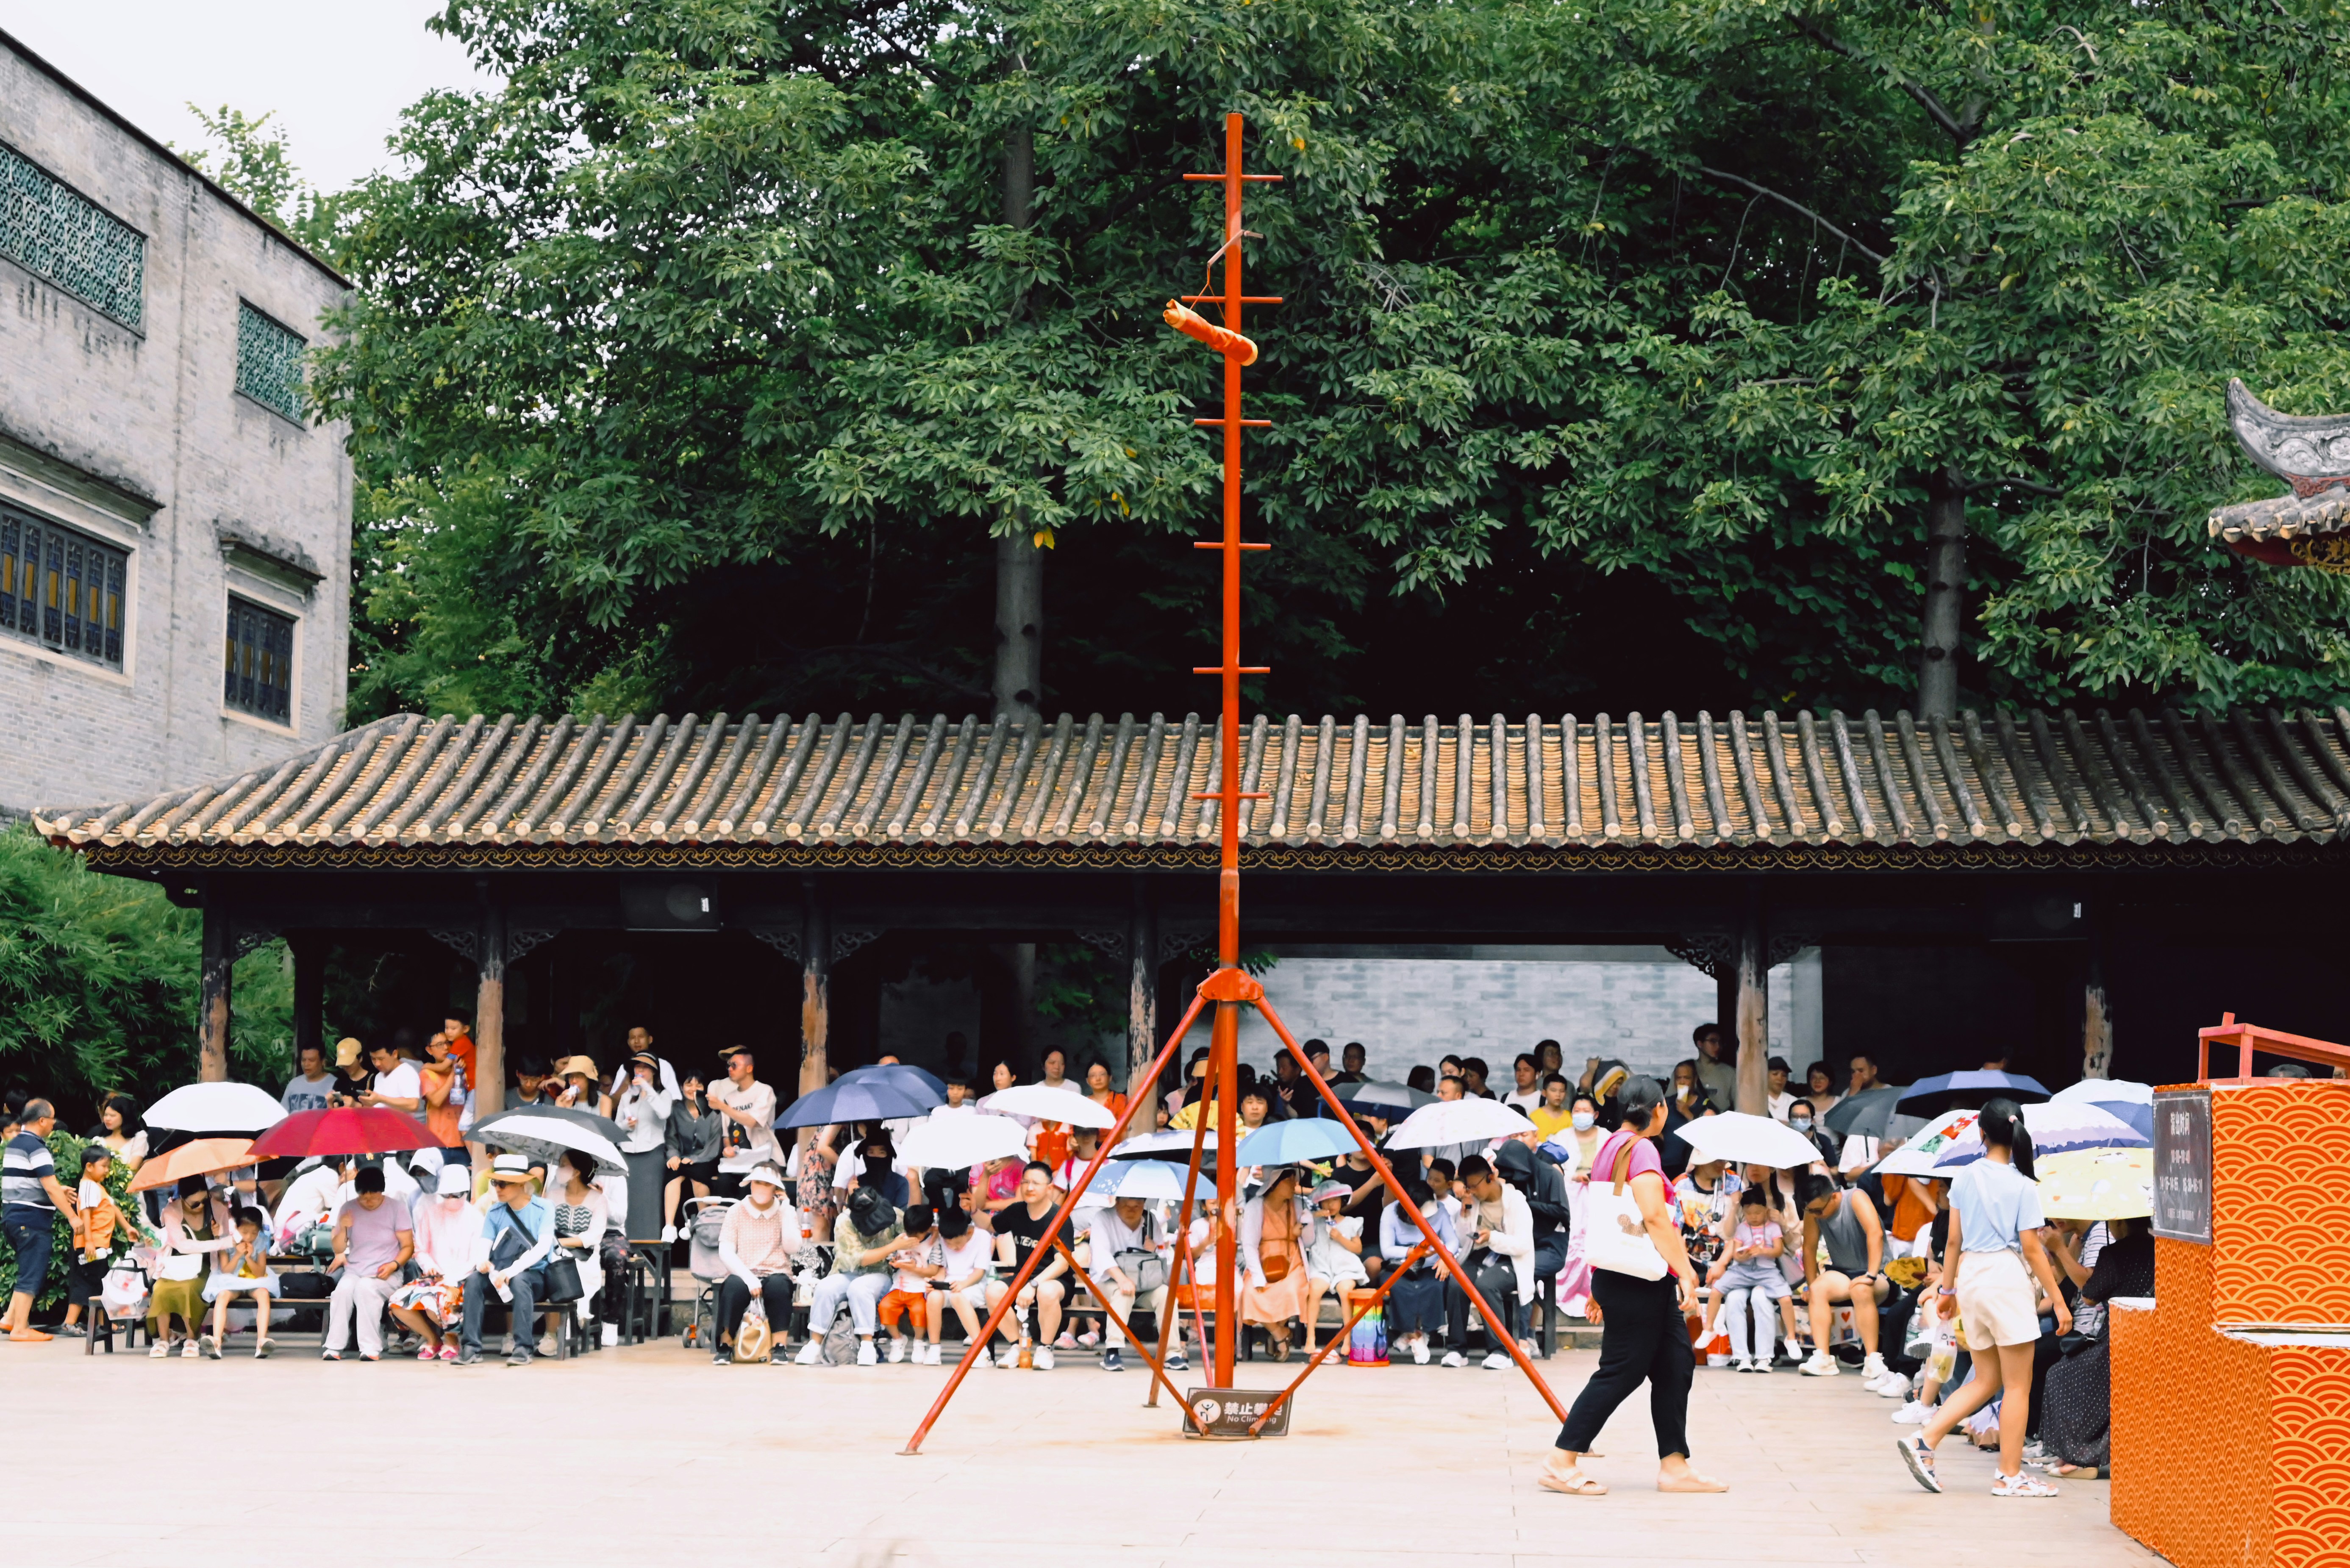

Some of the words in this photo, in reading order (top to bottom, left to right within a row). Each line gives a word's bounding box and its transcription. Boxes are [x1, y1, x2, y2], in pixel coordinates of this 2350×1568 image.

[2170, 1111, 2190, 1135] 演出时间
[1241, 1415, 1277, 1424] Climng
